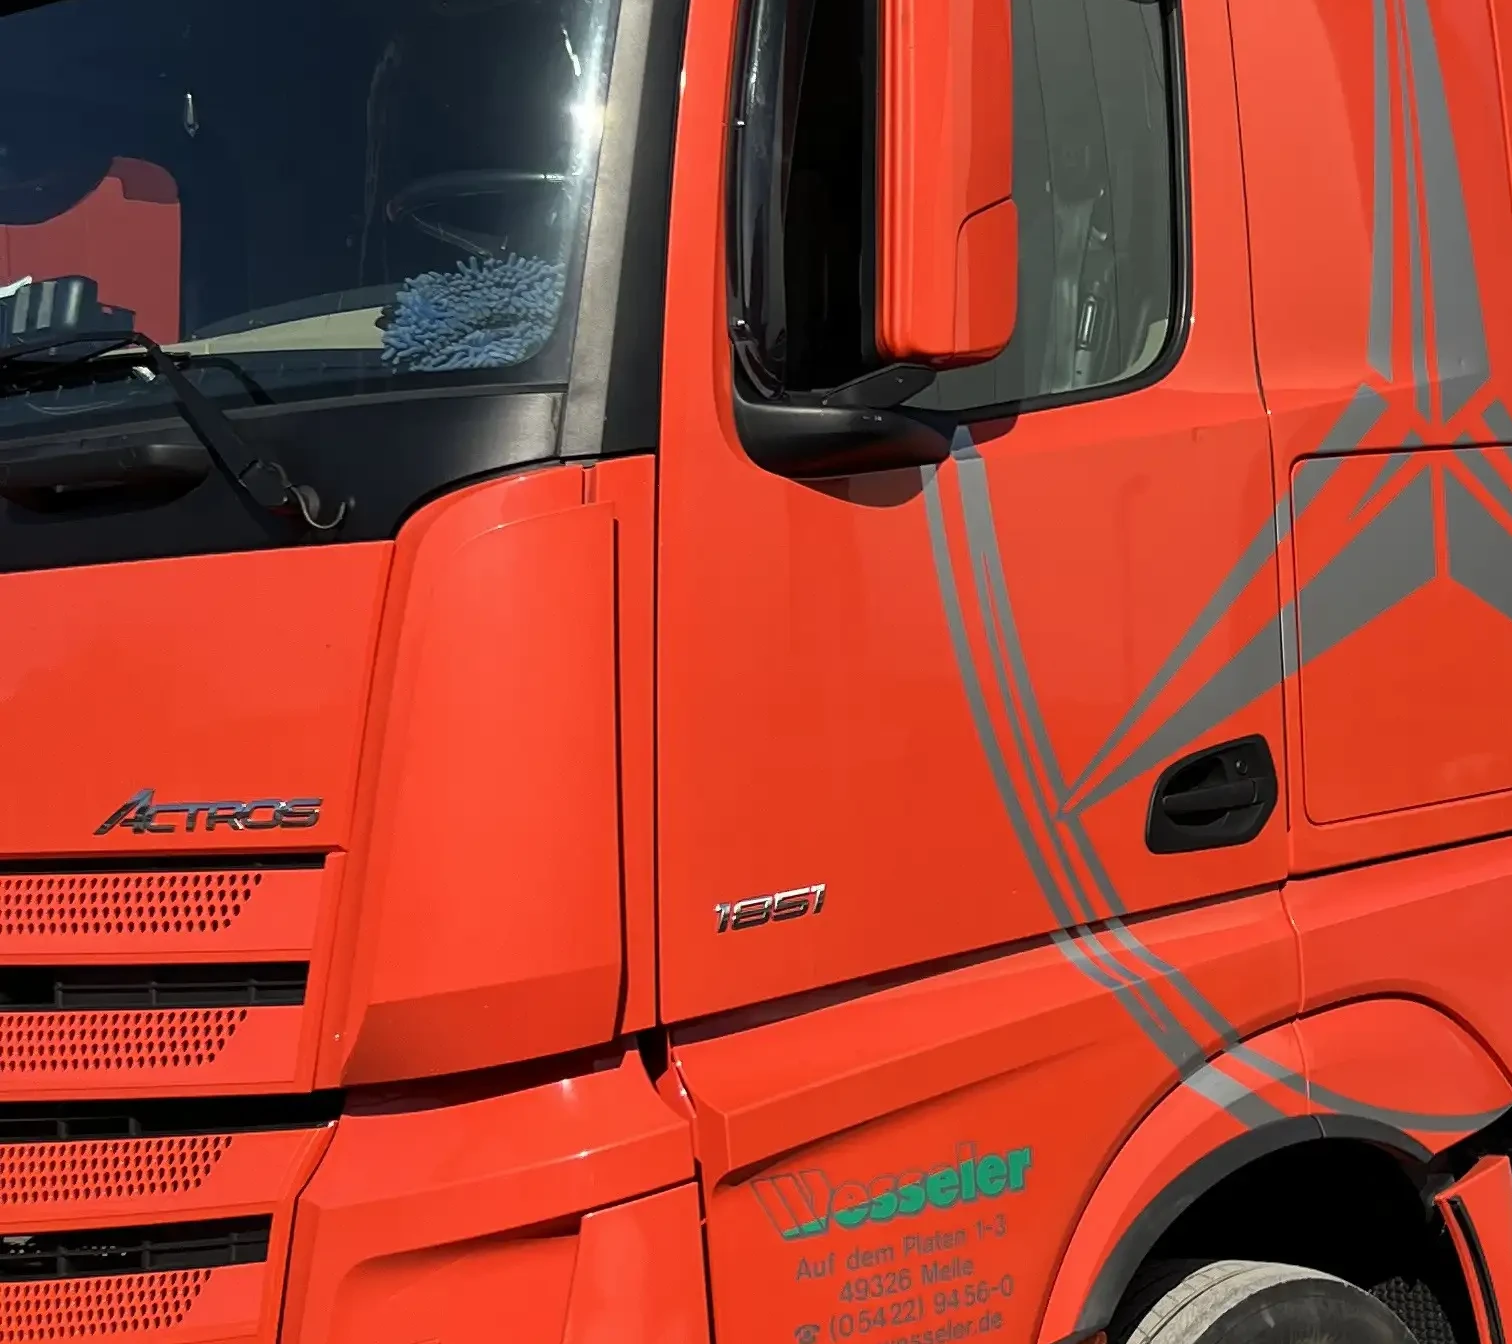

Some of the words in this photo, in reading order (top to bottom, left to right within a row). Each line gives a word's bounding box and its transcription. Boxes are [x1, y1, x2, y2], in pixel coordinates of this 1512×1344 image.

[714, 883, 826, 934] 1851
[750, 1140, 1032, 1240] Wesseler
[795, 1252, 835, 1281] Auf
[846, 1244, 894, 1271] dem
[902, 1227, 967, 1256] Platen
[975, 1214, 1007, 1238] 1-3
[839, 1268, 913, 1303] 49326
[920, 1257, 975, 1286] Melle
